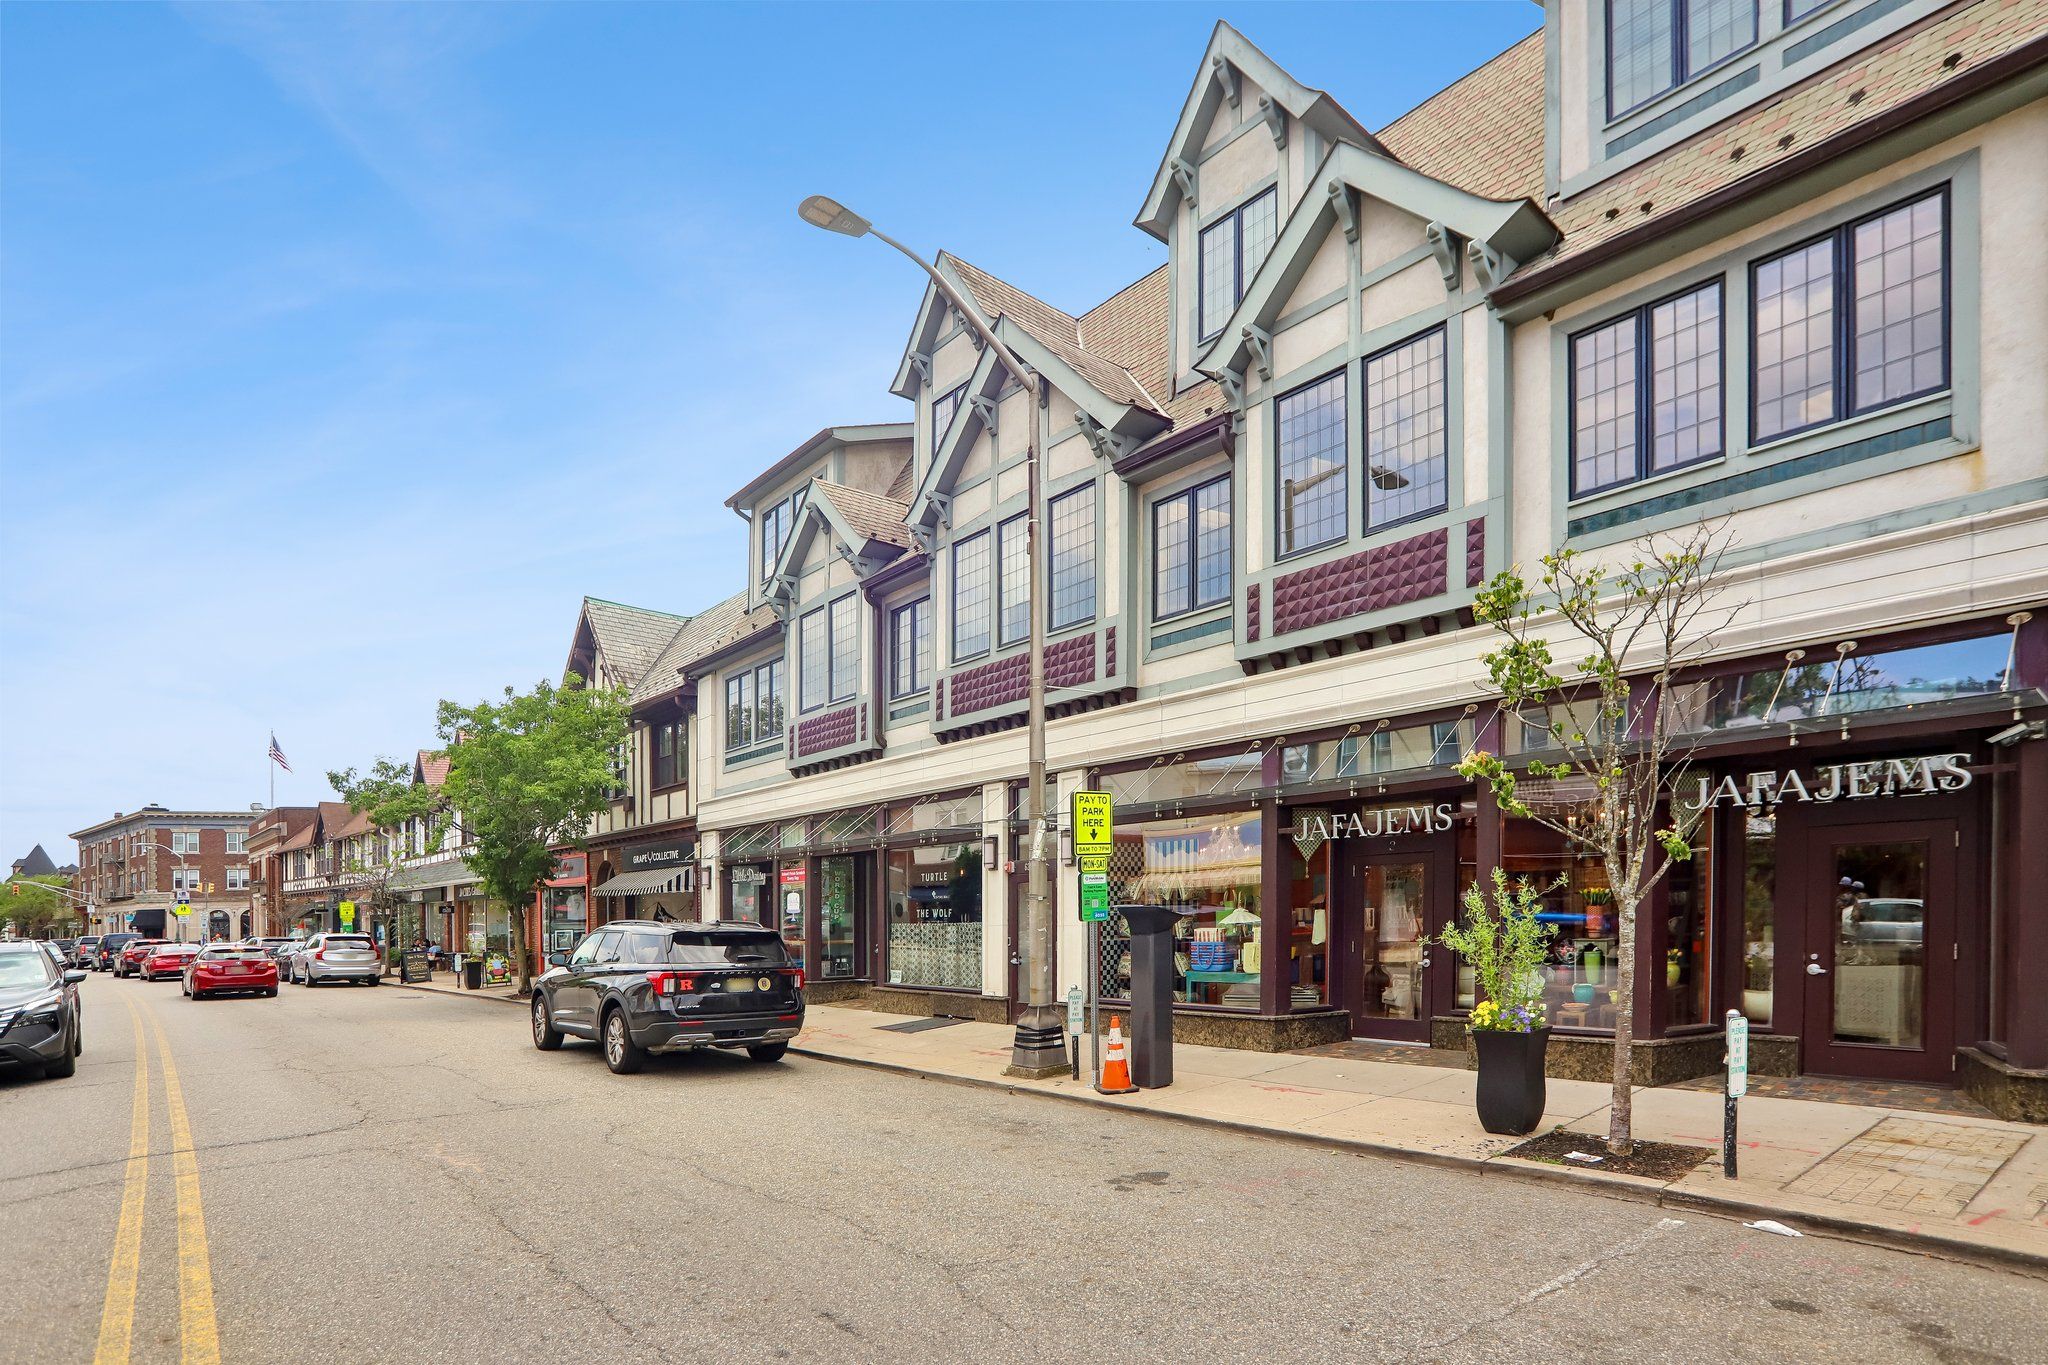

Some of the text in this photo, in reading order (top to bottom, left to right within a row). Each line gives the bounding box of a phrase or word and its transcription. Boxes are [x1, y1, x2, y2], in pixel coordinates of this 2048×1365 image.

[1685, 753, 1973, 809] JAFAJEMS
[1079, 796, 1108, 804] PAY TO
[1082, 807, 1104, 816] PARK
[1082, 818, 1104, 827] HERE
[1294, 804, 1453, 841] JAFAJEMS
[633, 849, 679, 864] GRAPE COLLECTIVE
[1083, 859, 1105, 869] MON-SAT
[731, 867, 767, 885] Little Daisy
[920, 871, 948, 882] TURTLE
[916, 908, 953, 919] THE WOLF
[680, 979, 694, 991] R
